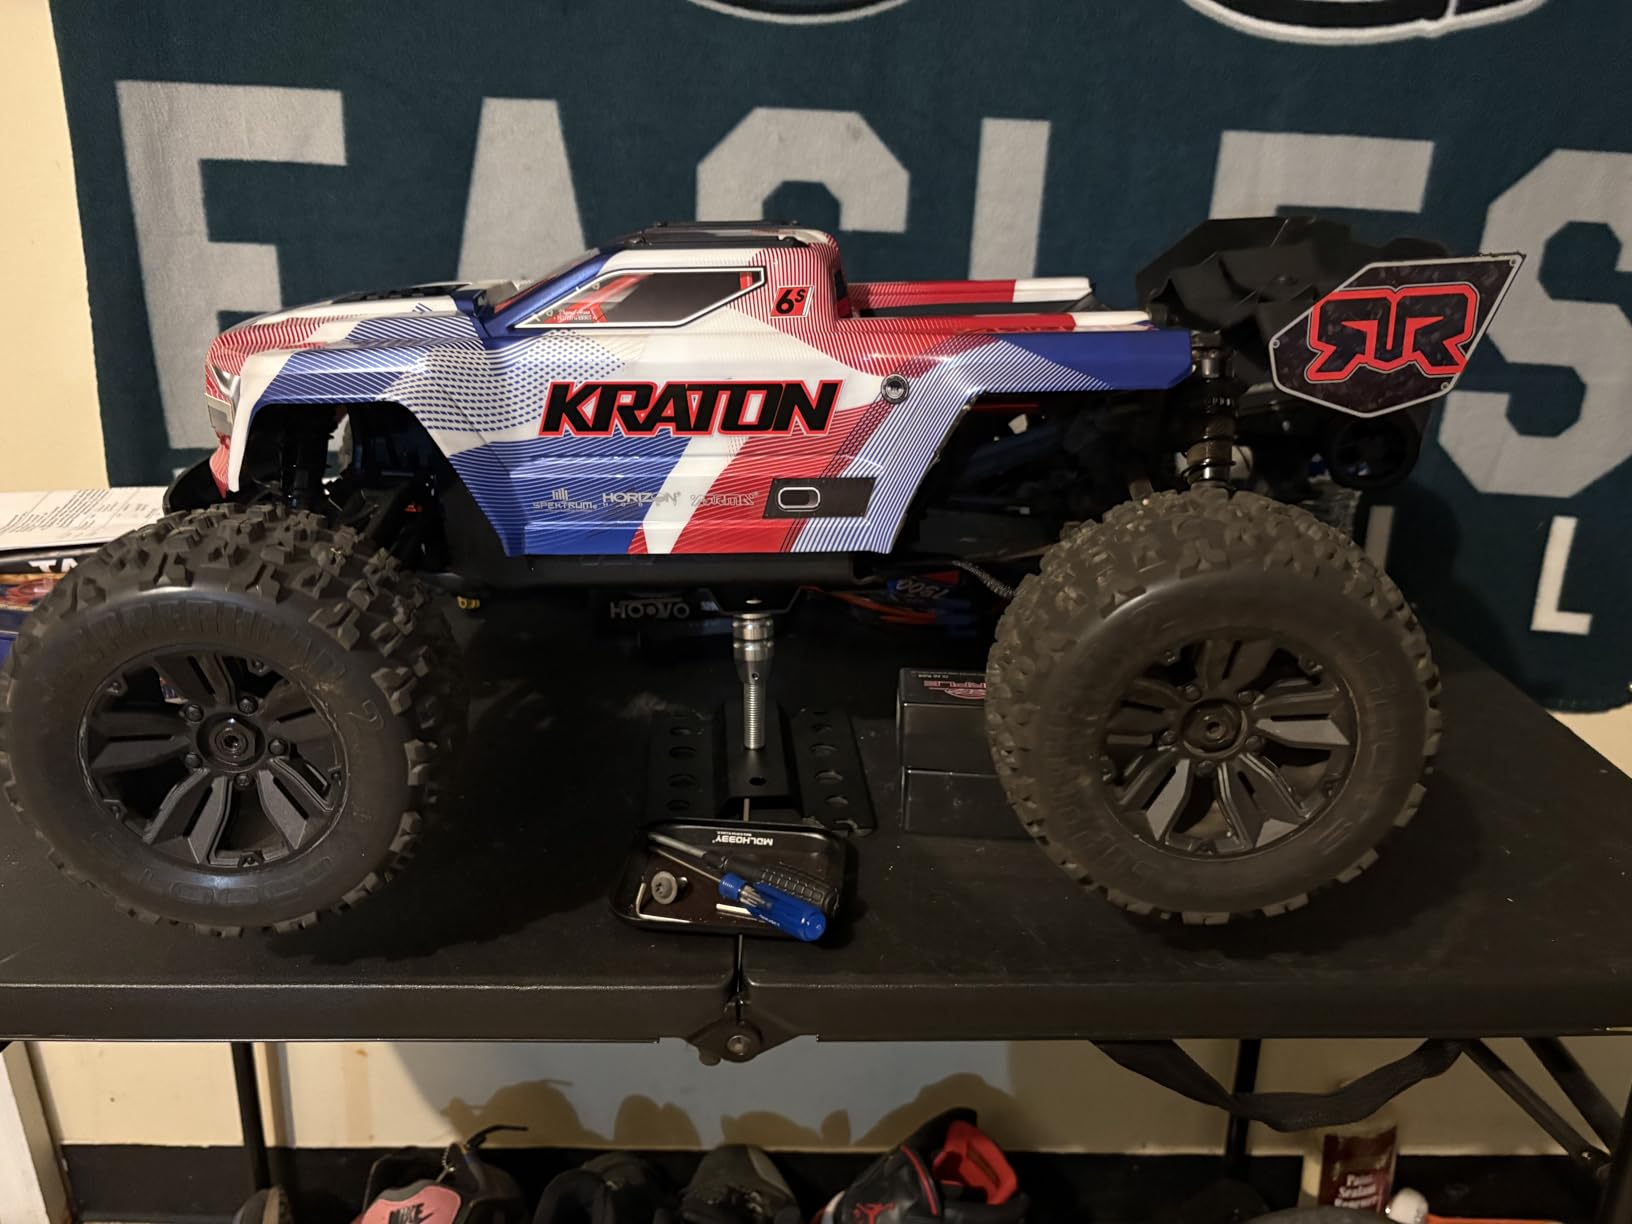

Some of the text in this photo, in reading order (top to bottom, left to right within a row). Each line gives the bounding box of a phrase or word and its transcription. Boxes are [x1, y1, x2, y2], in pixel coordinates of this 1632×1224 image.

[774, 287, 807, 316] 6S
[538, 379, 843, 438] KRATON
[602, 492, 677, 504] HORIZON
